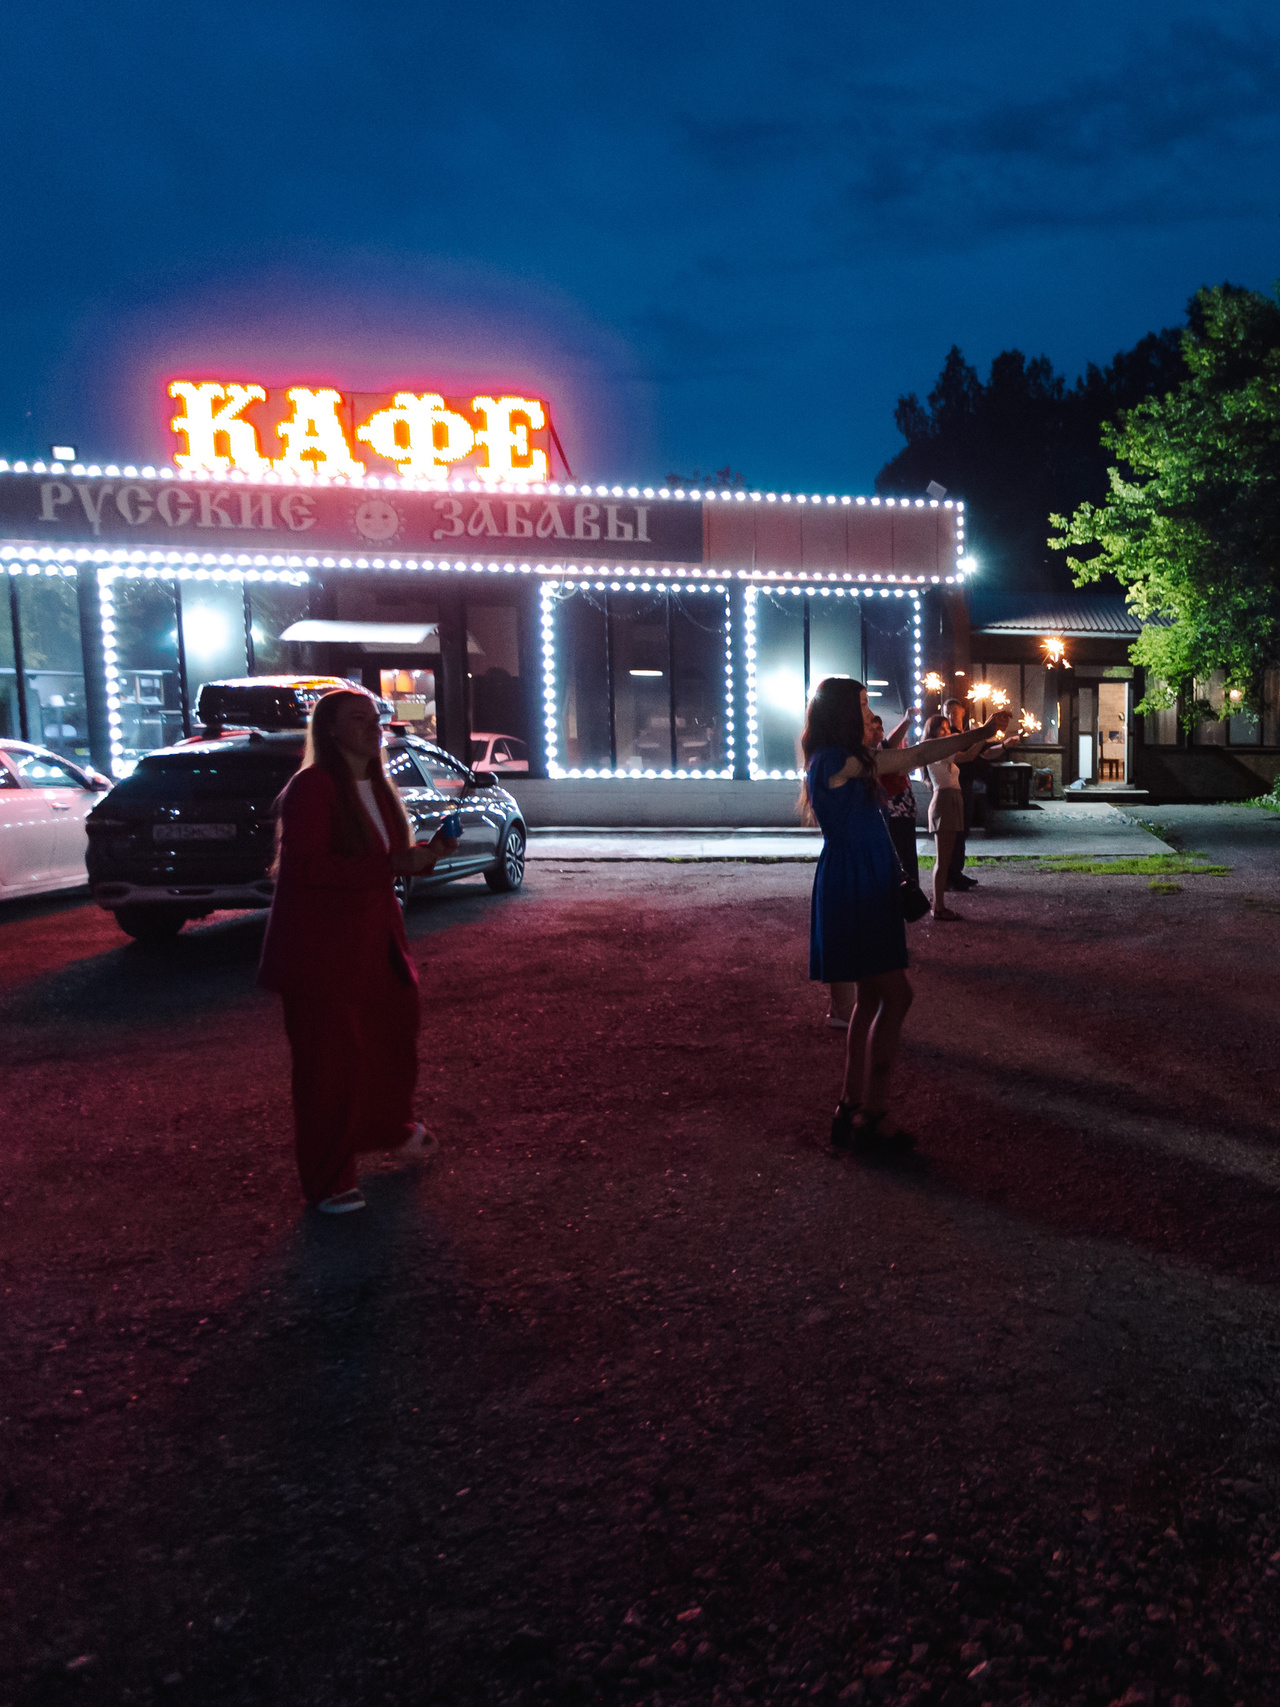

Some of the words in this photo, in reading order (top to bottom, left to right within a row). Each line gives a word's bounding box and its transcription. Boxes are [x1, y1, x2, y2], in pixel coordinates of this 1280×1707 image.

[169, 381, 548, 483] КАФЕ
[38, 482, 317, 536] РУССКИЕ
[433, 498, 651, 542] ЗАБАВЫ
